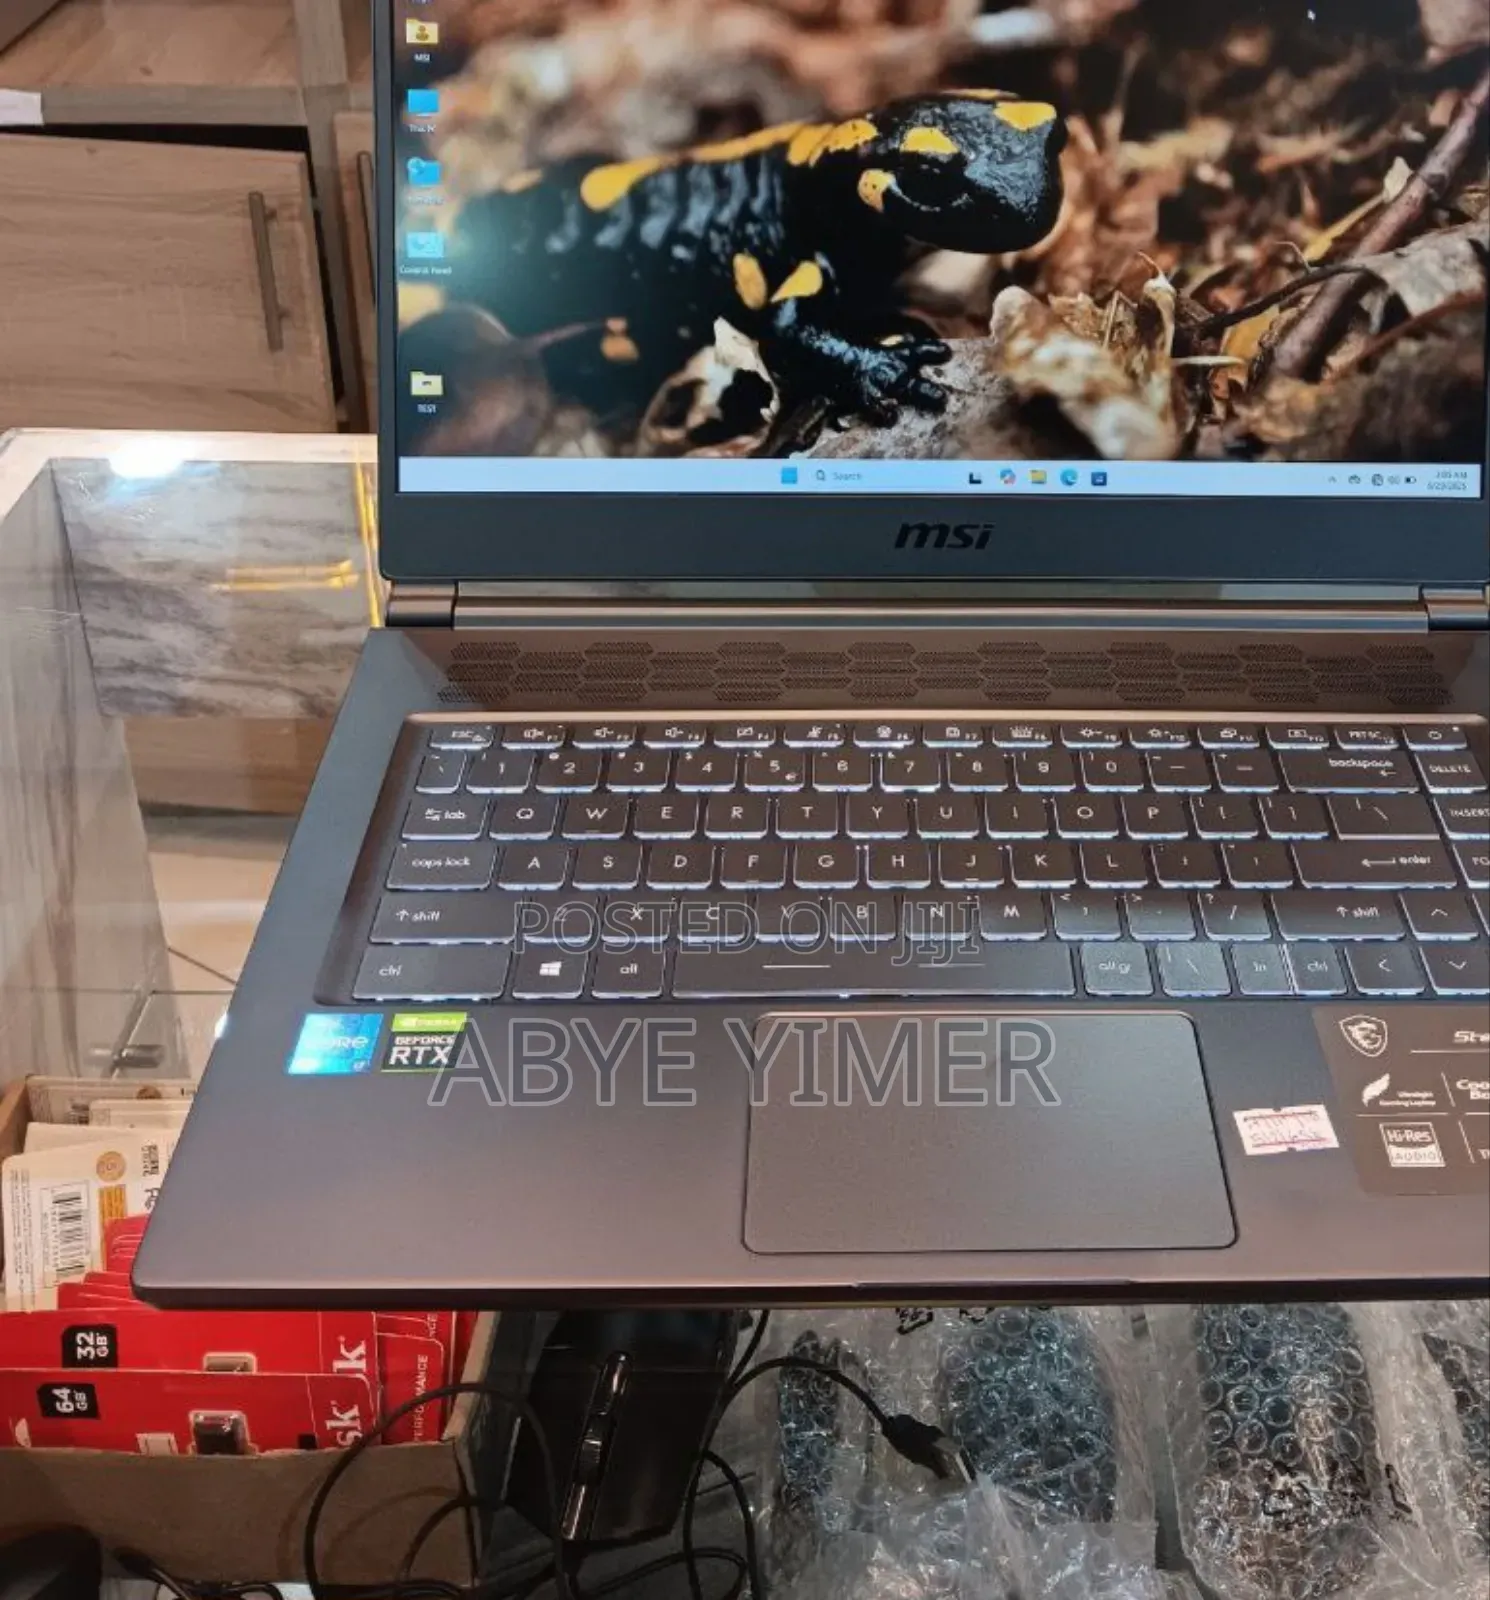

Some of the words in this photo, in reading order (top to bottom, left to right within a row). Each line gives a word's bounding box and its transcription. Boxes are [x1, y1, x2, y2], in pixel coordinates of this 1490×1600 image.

[832, 471, 863, 481] Search
[563, 762, 576, 775] 2
[633, 762, 645, 774] 3
[701, 762, 713, 774] 4
[769, 760, 781, 773] 5
[904, 760, 916, 773] 7
[1328, 758, 1395, 770] backspace
[1429, 764, 1472, 774] DELETE
[516, 808, 534, 820] Q
[585, 807, 608, 820] W
[661, 806, 673, 820] E
[731, 806, 744, 819] R
[802, 806, 814, 819] T
[871, 806, 883, 819] Y
[939, 806, 953, 819] U
[1147, 806, 1160, 820] P
[527, 856, 541, 869] A
[602, 856, 614, 869] S
[673, 855, 688, 868] D
[747, 855, 759, 868] F
[817, 854, 835, 868] G
[891, 855, 905, 868] H
[965, 854, 977, 868] J
[1034, 854, 1048, 867] K
[1106, 854, 1119, 867] L
[411, 910, 441, 921] shift
[629, 907, 644, 921] X
[856, 906, 869, 919] B
[930, 906, 944, 918] N
[1003, 905, 1020, 918] M
[1353, 906, 1380, 918] shift
[388, 1046, 453, 1065] RTX
[1387, 1129, 1432, 1142] Hi-Res
[76, 1331, 95, 1360] 32
[96, 1335, 109, 1358] GB
[52, 1387, 75, 1413] 64
[75, 1391, 88, 1411] GB
